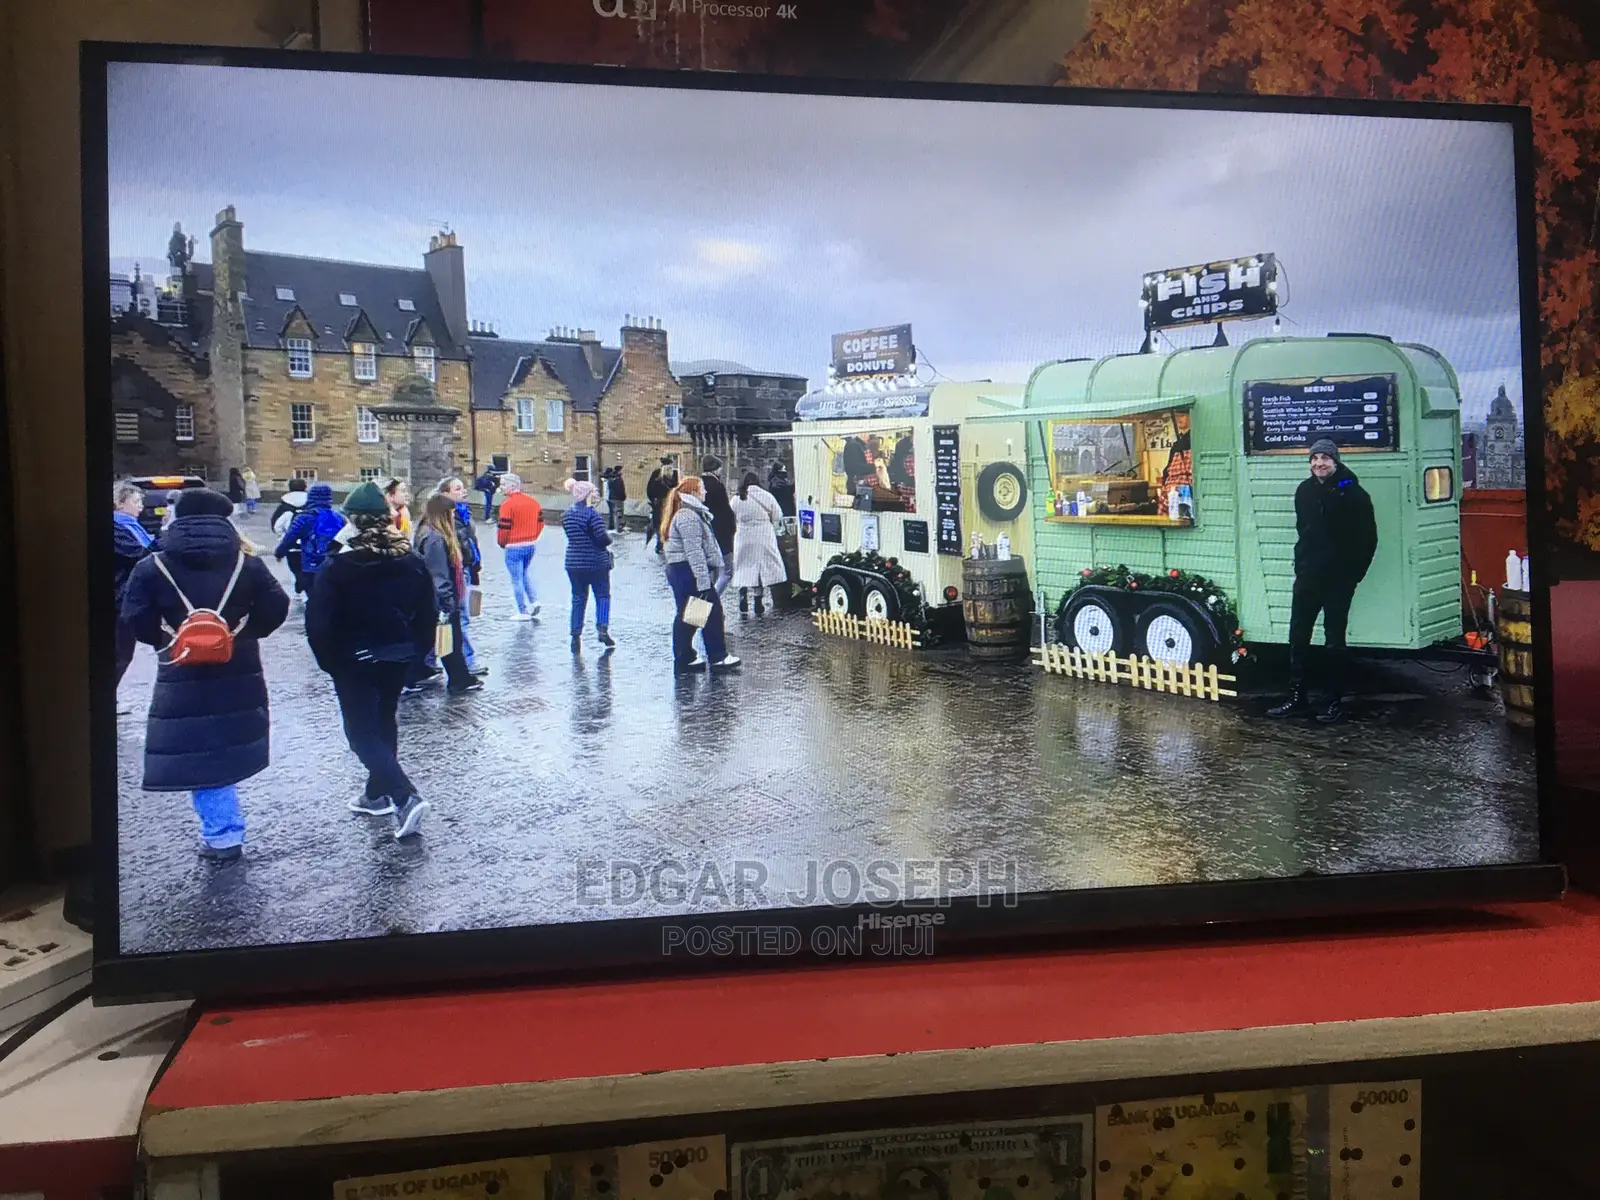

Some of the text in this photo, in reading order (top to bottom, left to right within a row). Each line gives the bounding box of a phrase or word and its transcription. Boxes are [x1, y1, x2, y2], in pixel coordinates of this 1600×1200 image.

[692, 0, 771, 18] Processor
[776, 4, 798, 20] 4K
[1157, 263, 1261, 301] FISH
[1171, 299, 1244, 318] CHIPS
[1192, 294, 1220, 305] AND
[842, 334, 898, 354] COFFEE
[847, 359, 895, 373] DONUTS
[1303, 385, 1335, 393] MENU
[1262, 406, 1285, 414] Scottish
[857, 910, 946, 930] Hisense
[1357, 1088, 1409, 1106] 50000
[1175, 1100, 1241, 1120] UGANDA
[402, 1179, 428, 1195] OF
[432, 1167, 511, 1191] UGANDA
